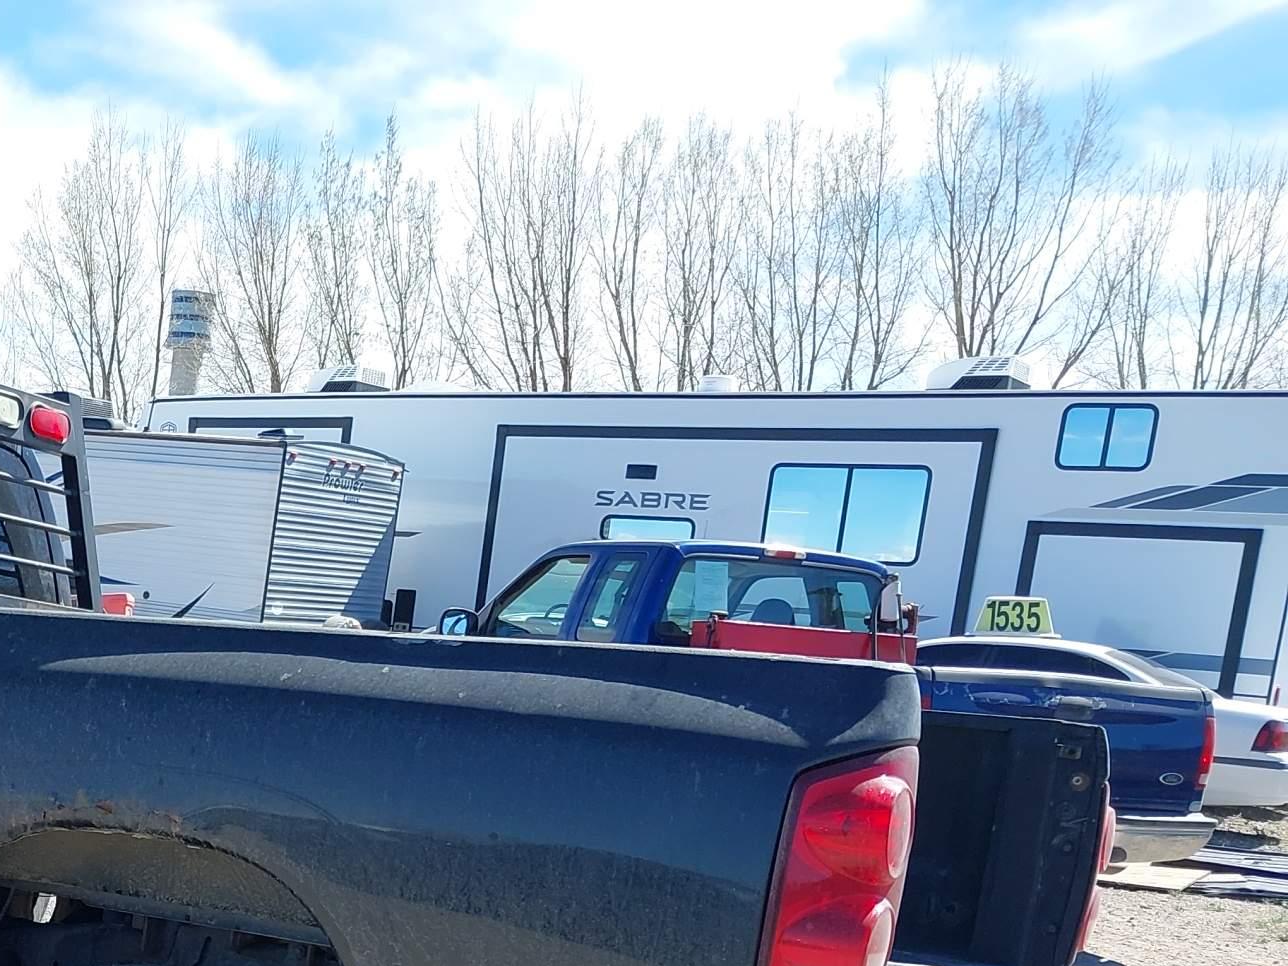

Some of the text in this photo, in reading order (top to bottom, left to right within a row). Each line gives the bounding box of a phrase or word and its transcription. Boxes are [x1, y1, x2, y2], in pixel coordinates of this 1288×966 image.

[323, 472, 364, 492] Prowler
[594, 490, 712, 511] SABRE
[986, 600, 1041, 633] 1535
